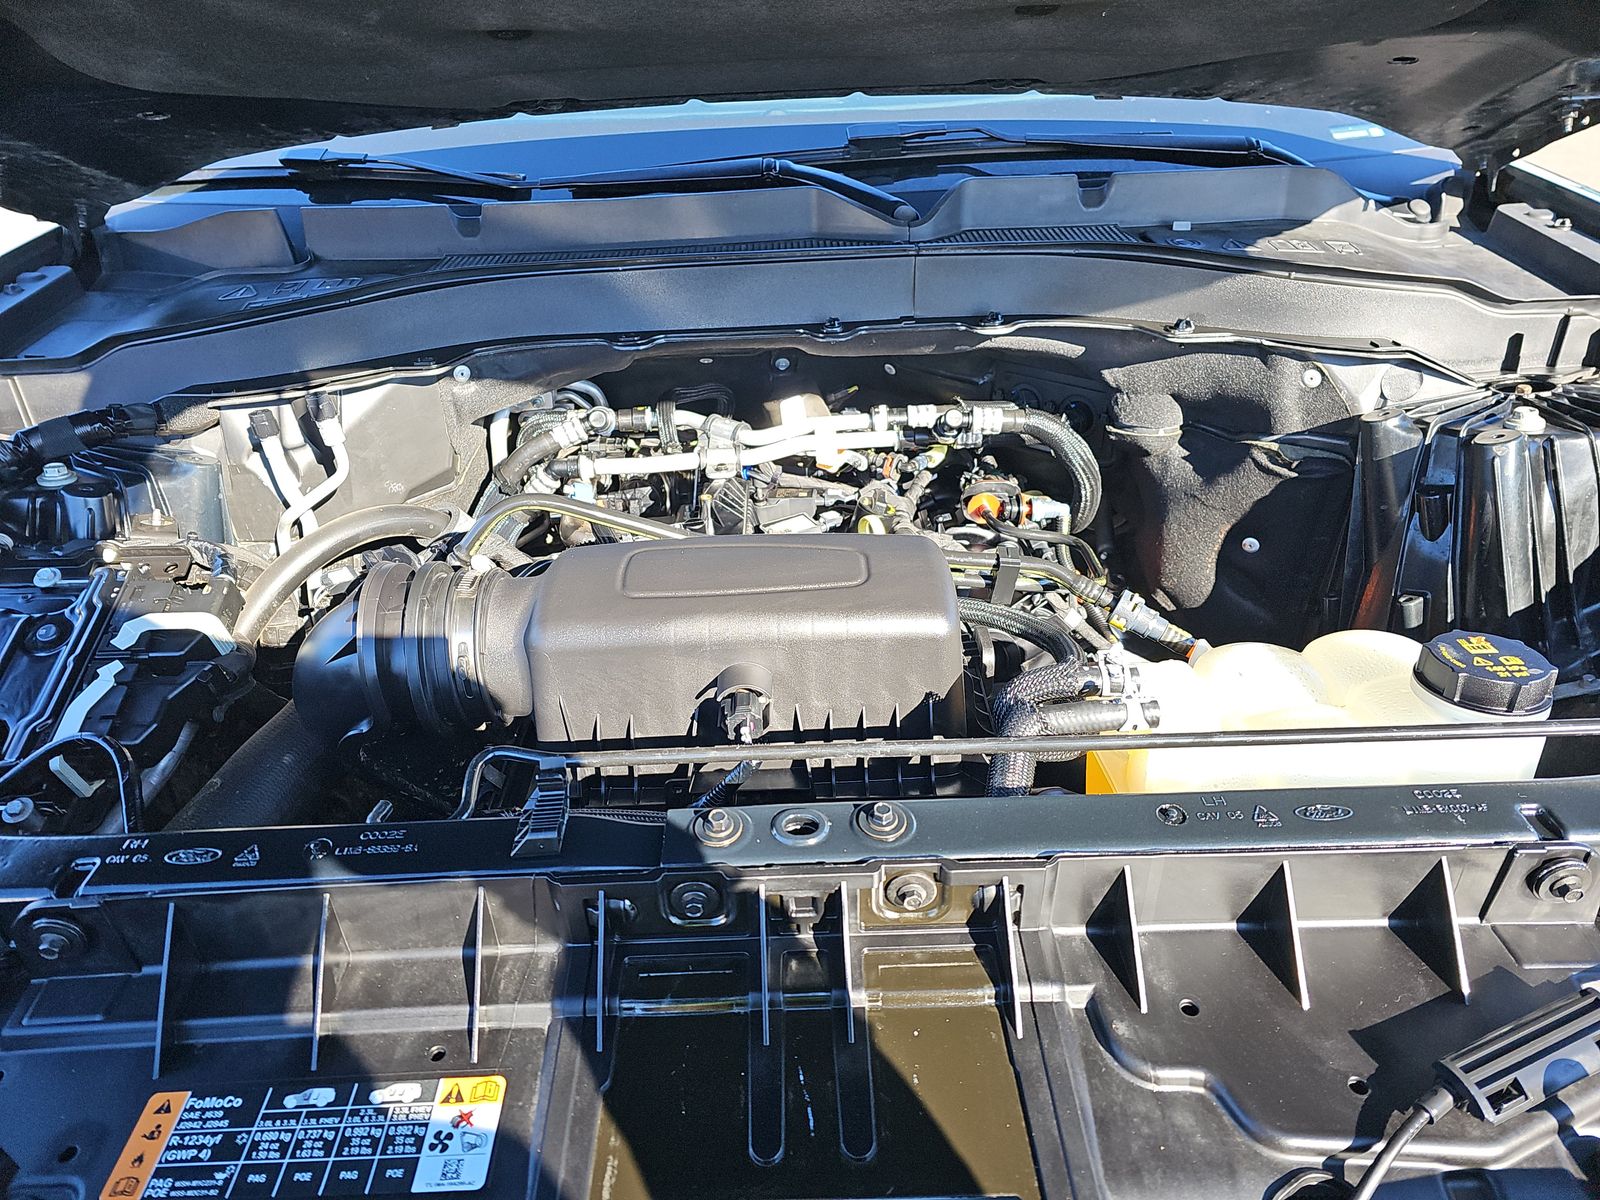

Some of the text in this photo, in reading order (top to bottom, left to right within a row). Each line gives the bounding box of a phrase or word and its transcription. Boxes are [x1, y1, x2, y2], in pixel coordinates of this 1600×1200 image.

[1202, 796, 1227, 807] LH
[185, 1096, 243, 1110] FoMoCo
[181, 1111, 202, 1120] SAE
[298, 1129, 336, 1141] 0.737 kg
[370, 1126, 383, 1138] kg
[413, 1125, 427, 1136] kg
[168, 1133, 224, 1147] R-1234yf
[279, 1131, 292, 1142] kg
[269, 1142, 280, 1150] oz
[313, 1140, 324, 1148] oz
[361, 1138, 371, 1146] oz
[312, 1149, 325, 1158] lbs
[359, 1147, 373, 1155] lbs
[403, 1145, 417, 1153] lbs
[161, 1148, 212, 1163] (GWP 4)
[268, 1150, 281, 1159] lbs
[246, 1173, 268, 1183] PAG
[293, 1171, 313, 1182] POE
[339, 1170, 359, 1180] PAG
[385, 1168, 405, 1178] POE
[149, 1177, 174, 1189] PAG
[143, 1187, 171, 1199] POE
